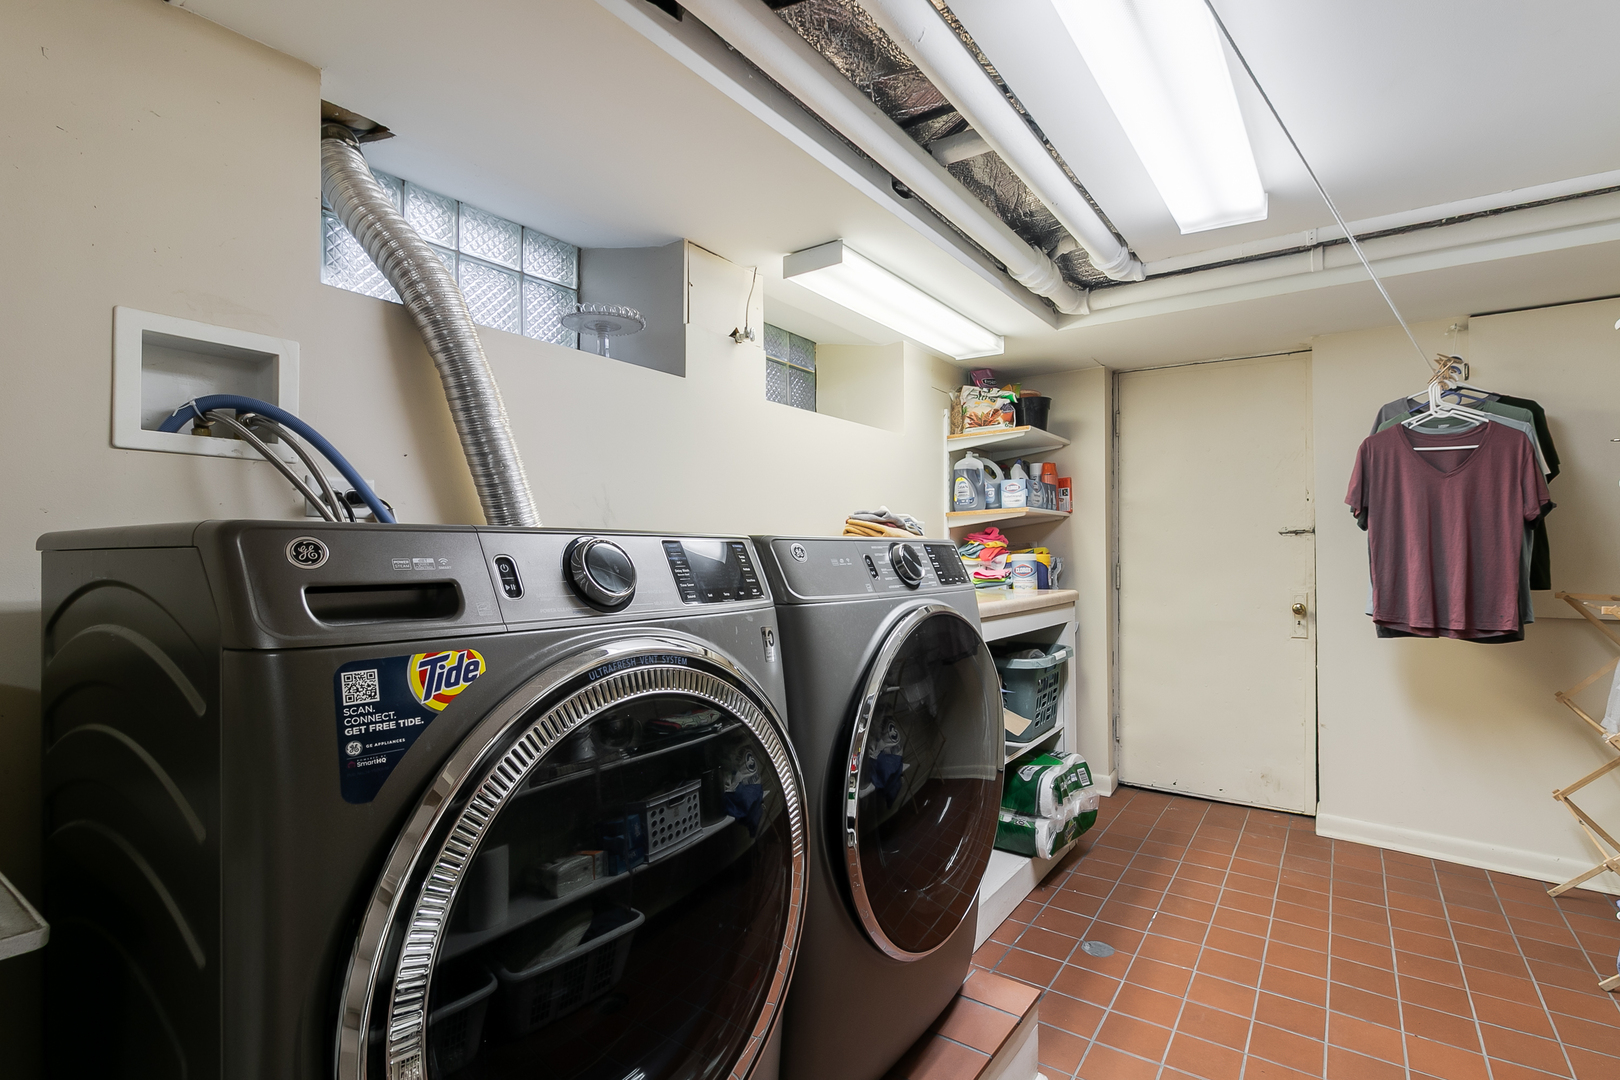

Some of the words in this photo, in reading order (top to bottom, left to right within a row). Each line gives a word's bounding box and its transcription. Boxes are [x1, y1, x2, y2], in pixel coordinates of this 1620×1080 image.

[588, 658, 637, 681] ULTRAFRESH
[640, 655, 658, 665] VENT
[661, 655, 688, 665] SYSTEM
[417, 651, 480, 703] Tide
[343, 705, 376, 716] SCAN.
[344, 711, 397, 726] CONNECT.
[344, 725, 367, 736] GET
[369, 721, 397, 732] FREE
[398, 717, 425, 727] TIDE.
[374, 738, 406, 747] APPLIANCES
[356, 757, 387, 768] SmartHQ
